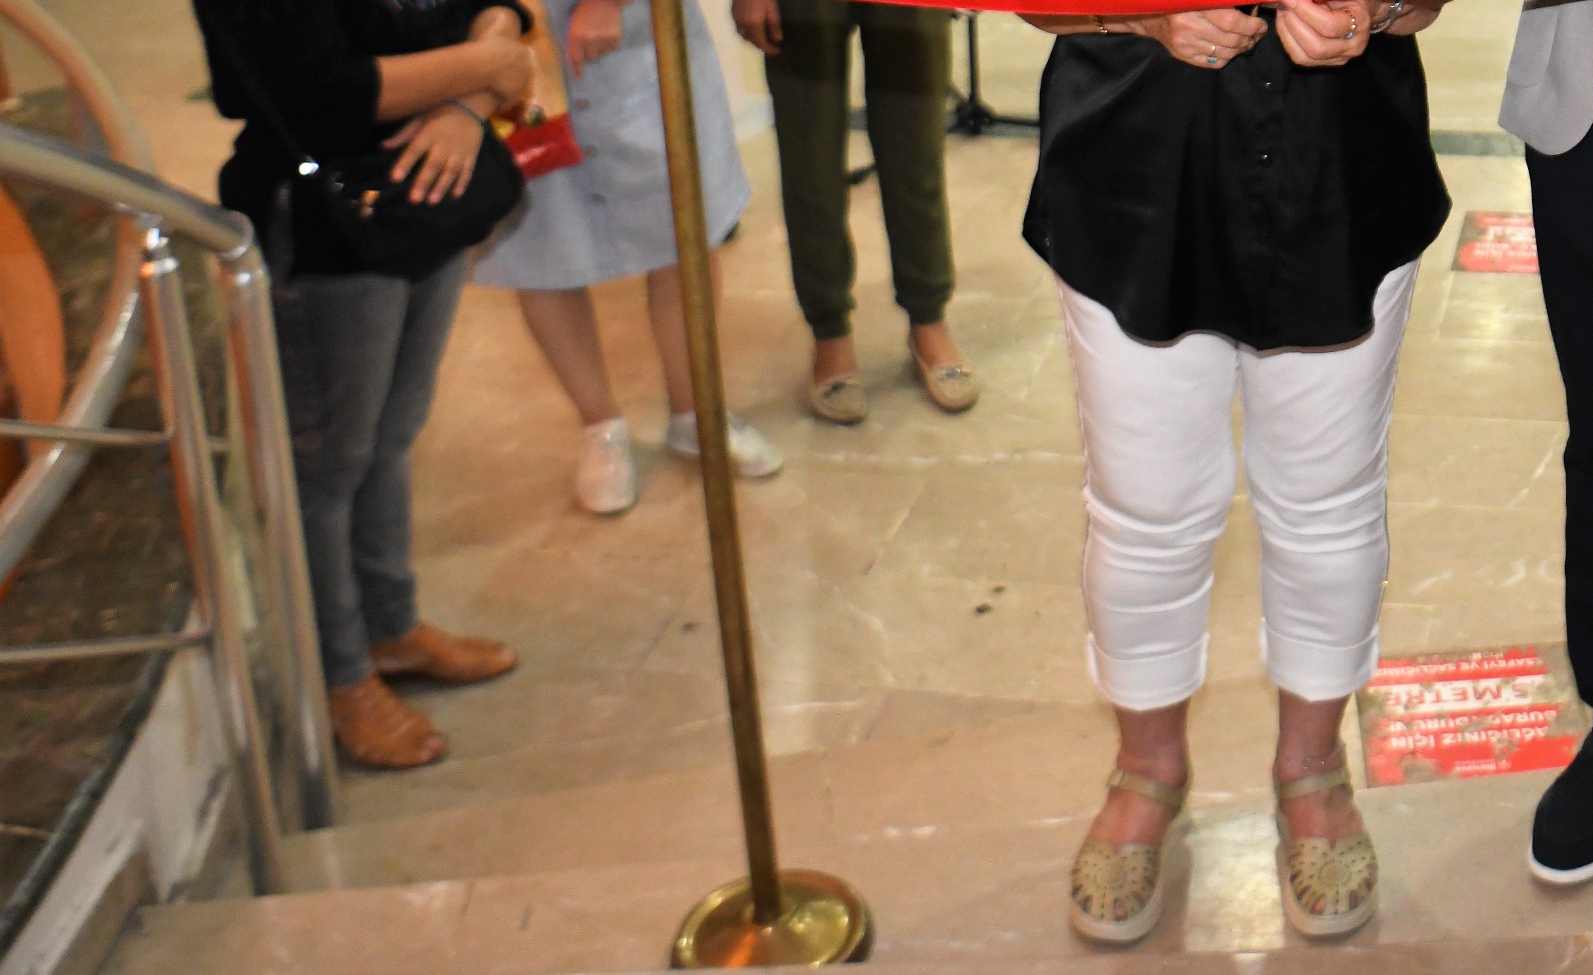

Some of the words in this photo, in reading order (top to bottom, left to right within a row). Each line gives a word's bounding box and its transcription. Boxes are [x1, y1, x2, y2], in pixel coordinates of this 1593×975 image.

[1388, 684, 1502, 706] METRE
[1391, 731, 1436, 750] İÇİN
[1442, 725, 1549, 745] AĞLIĞINIZ
